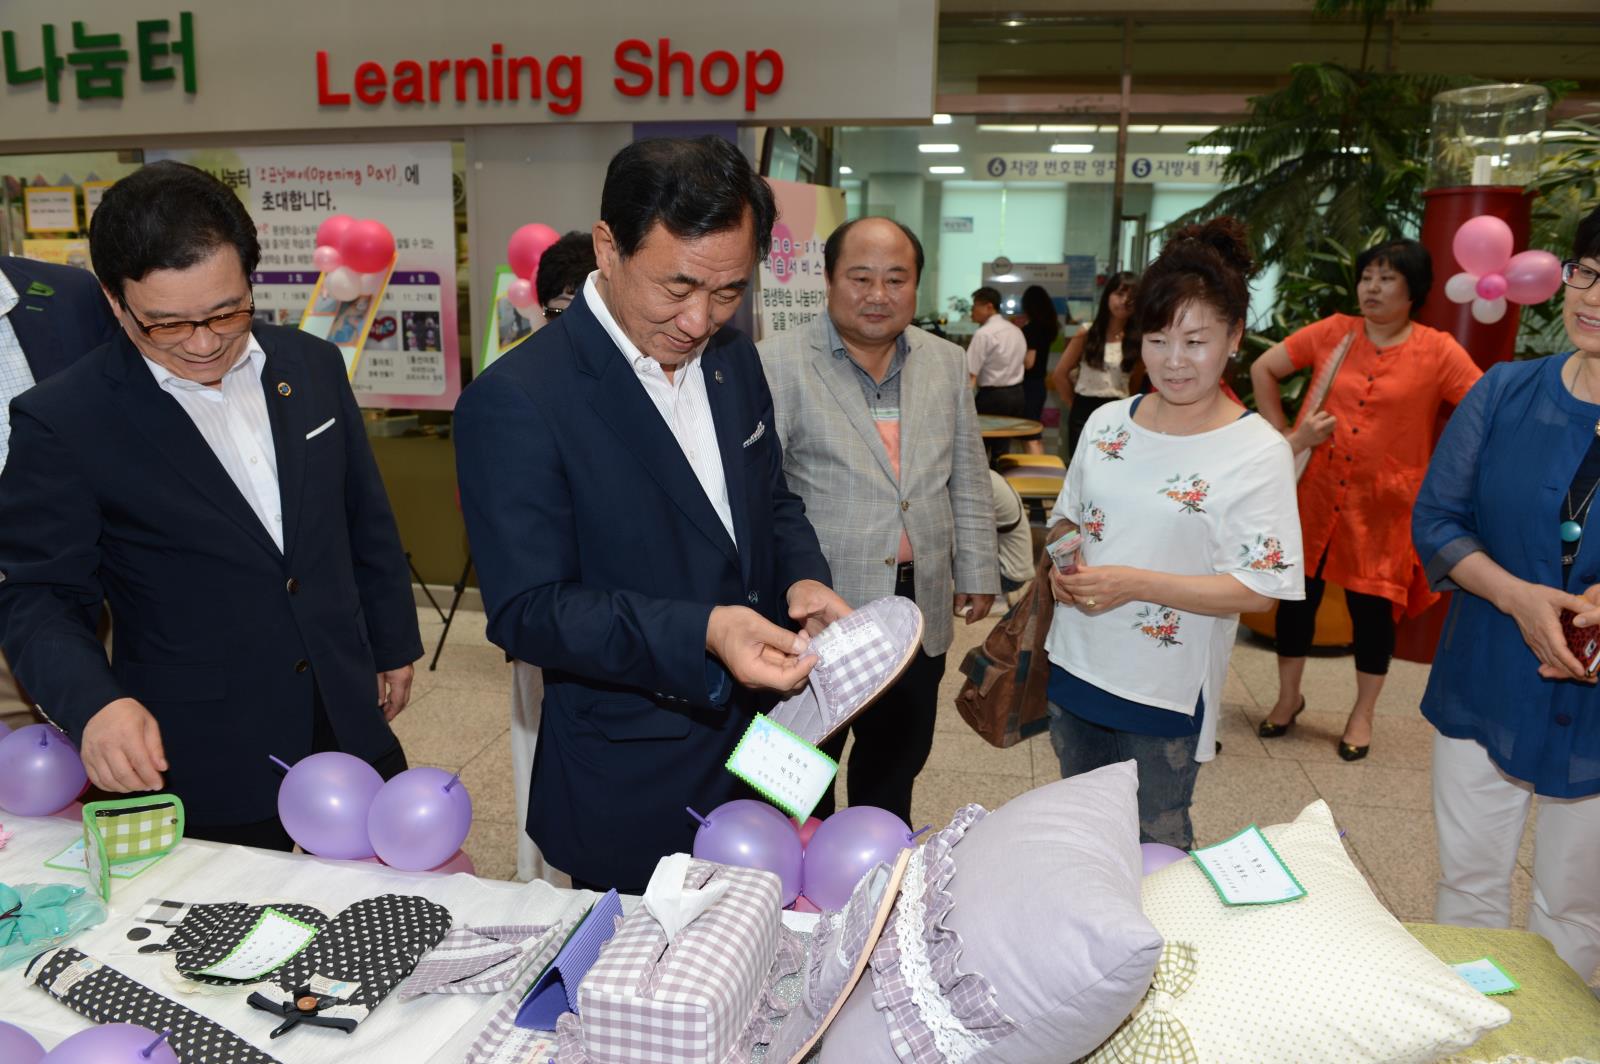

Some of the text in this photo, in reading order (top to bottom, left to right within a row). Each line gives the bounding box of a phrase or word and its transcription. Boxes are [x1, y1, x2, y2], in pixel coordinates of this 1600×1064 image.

[2, 12, 196, 103] 나눔터
[315, 38, 784, 115] Learning Shop
[262, 190, 337, 211] 초대합니다.
